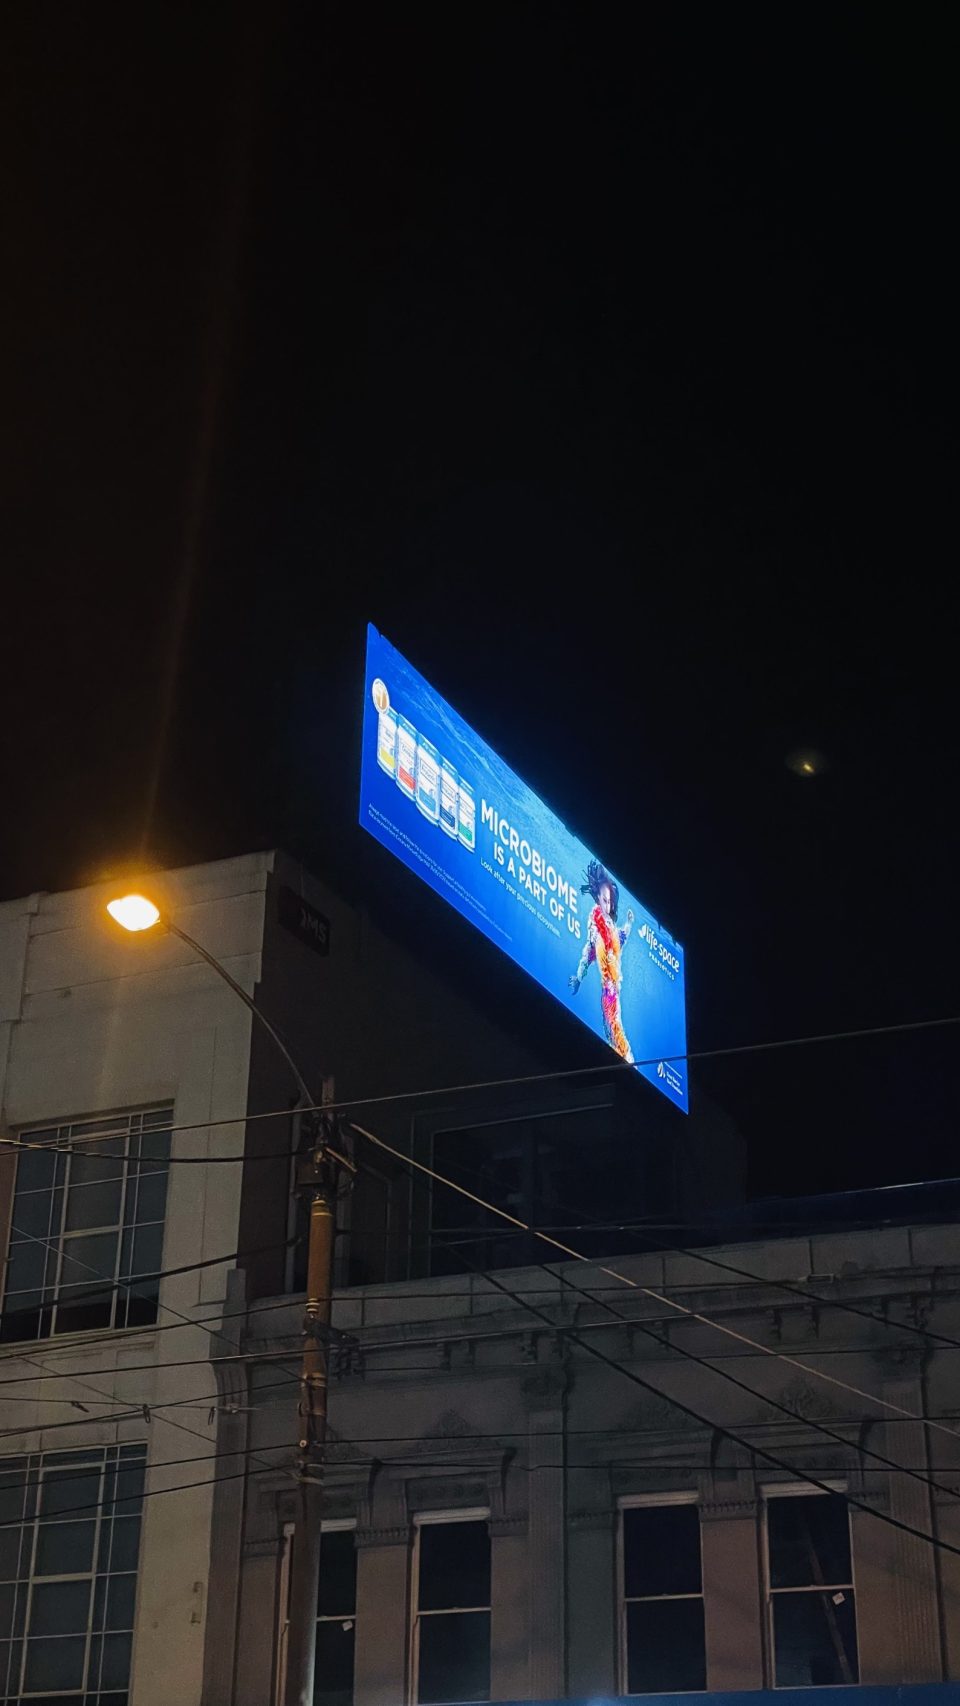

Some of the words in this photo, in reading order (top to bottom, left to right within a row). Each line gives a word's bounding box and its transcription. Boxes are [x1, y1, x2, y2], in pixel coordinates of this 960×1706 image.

[480, 857, 493, 875] Look
[493, 870, 505, 886] after
[505, 881, 517, 896] your
[481, 798, 578, 914] MICROBIOME
[493, 841, 505, 866] IS
[507, 857, 516, 878] A
[518, 866, 547, 906] PART
[549, 897, 565, 921] OF
[567, 912, 581, 939] US
